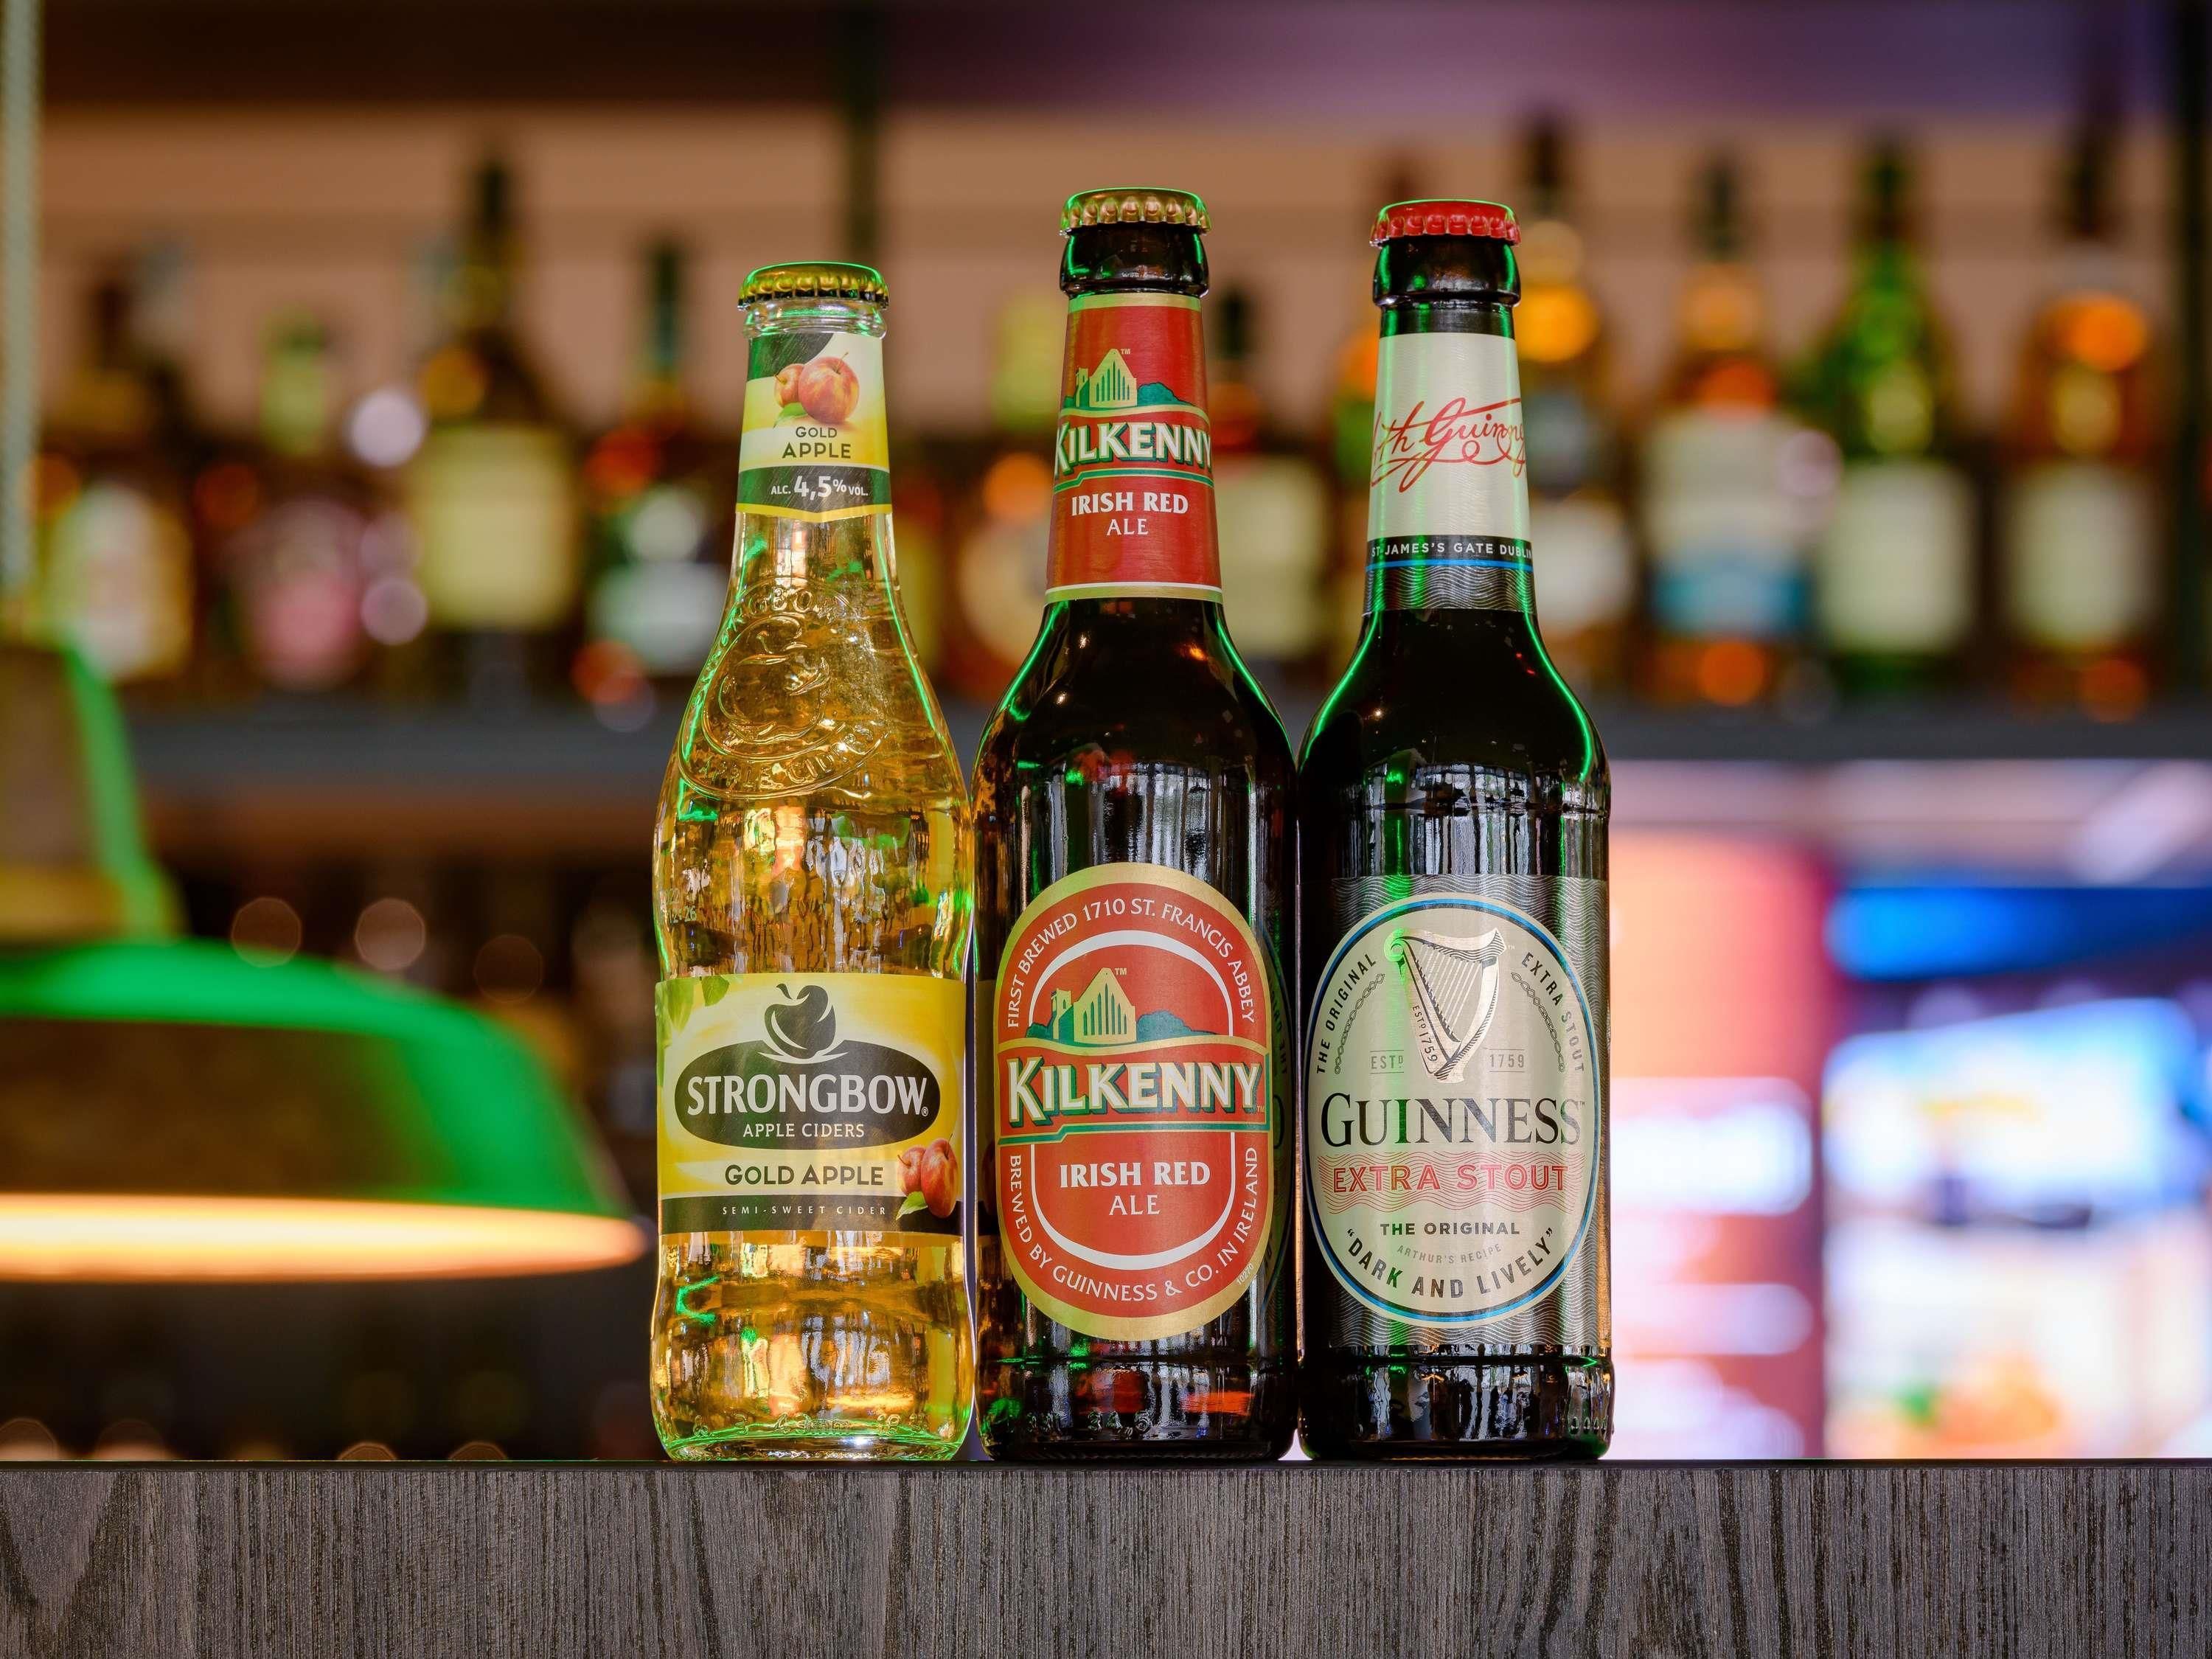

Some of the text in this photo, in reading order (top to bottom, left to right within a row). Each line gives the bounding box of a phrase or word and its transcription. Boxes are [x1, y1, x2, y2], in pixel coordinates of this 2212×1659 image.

[796, 426, 837, 439] GOLD
[782, 442, 851, 459] APPLE
[1054, 421, 1212, 476] KILKENNY
[771, 476, 869, 501] ALC. 4,5% VOL.
[1071, 492, 1189, 516] IRISH RED
[1107, 518, 1149, 536] ALE
[1385, 543, 1445, 555] JAMES'S
[1453, 542, 1494, 554] GATE
[1007, 898, 1256, 1028] FIRST BREWED 1710 ST. FRANCIS ABBEY
[1114, 968, 1127, 976] TM
[1316, 953, 1377, 1074] THE ORIGINAL
[1521, 952, 1585, 1071] EXTRA STOUT
[1419, 1032, 1438, 1062] 1759
[1489, 1054, 1525, 1069] 1759
[1006, 1055, 1262, 1128] KILKENNY
[743, 1123, 865, 1138] APPLE CIDERS
[1321, 1092, 1581, 1147] GUINNESS
[725, 1164, 883, 1186] GOLD APPLE
[1060, 1161, 1211, 1189] IRISH RED
[1333, 1164, 1568, 1192] EXTRA STOUT
[723, 1206, 886, 1215] SEMI-SWEET CIDER
[1108, 1194, 1160, 1216] ALE
[1009, 1147, 1258, 1301] BREWED BY GUINNESS & CO. IN IRELAND
[1380, 1222, 1520, 1236] THE ORIGINAL
[1397, 1243, 1502, 1265] ARTHUR'S RECIPE
[1411, 1276, 1464, 1298] AND
